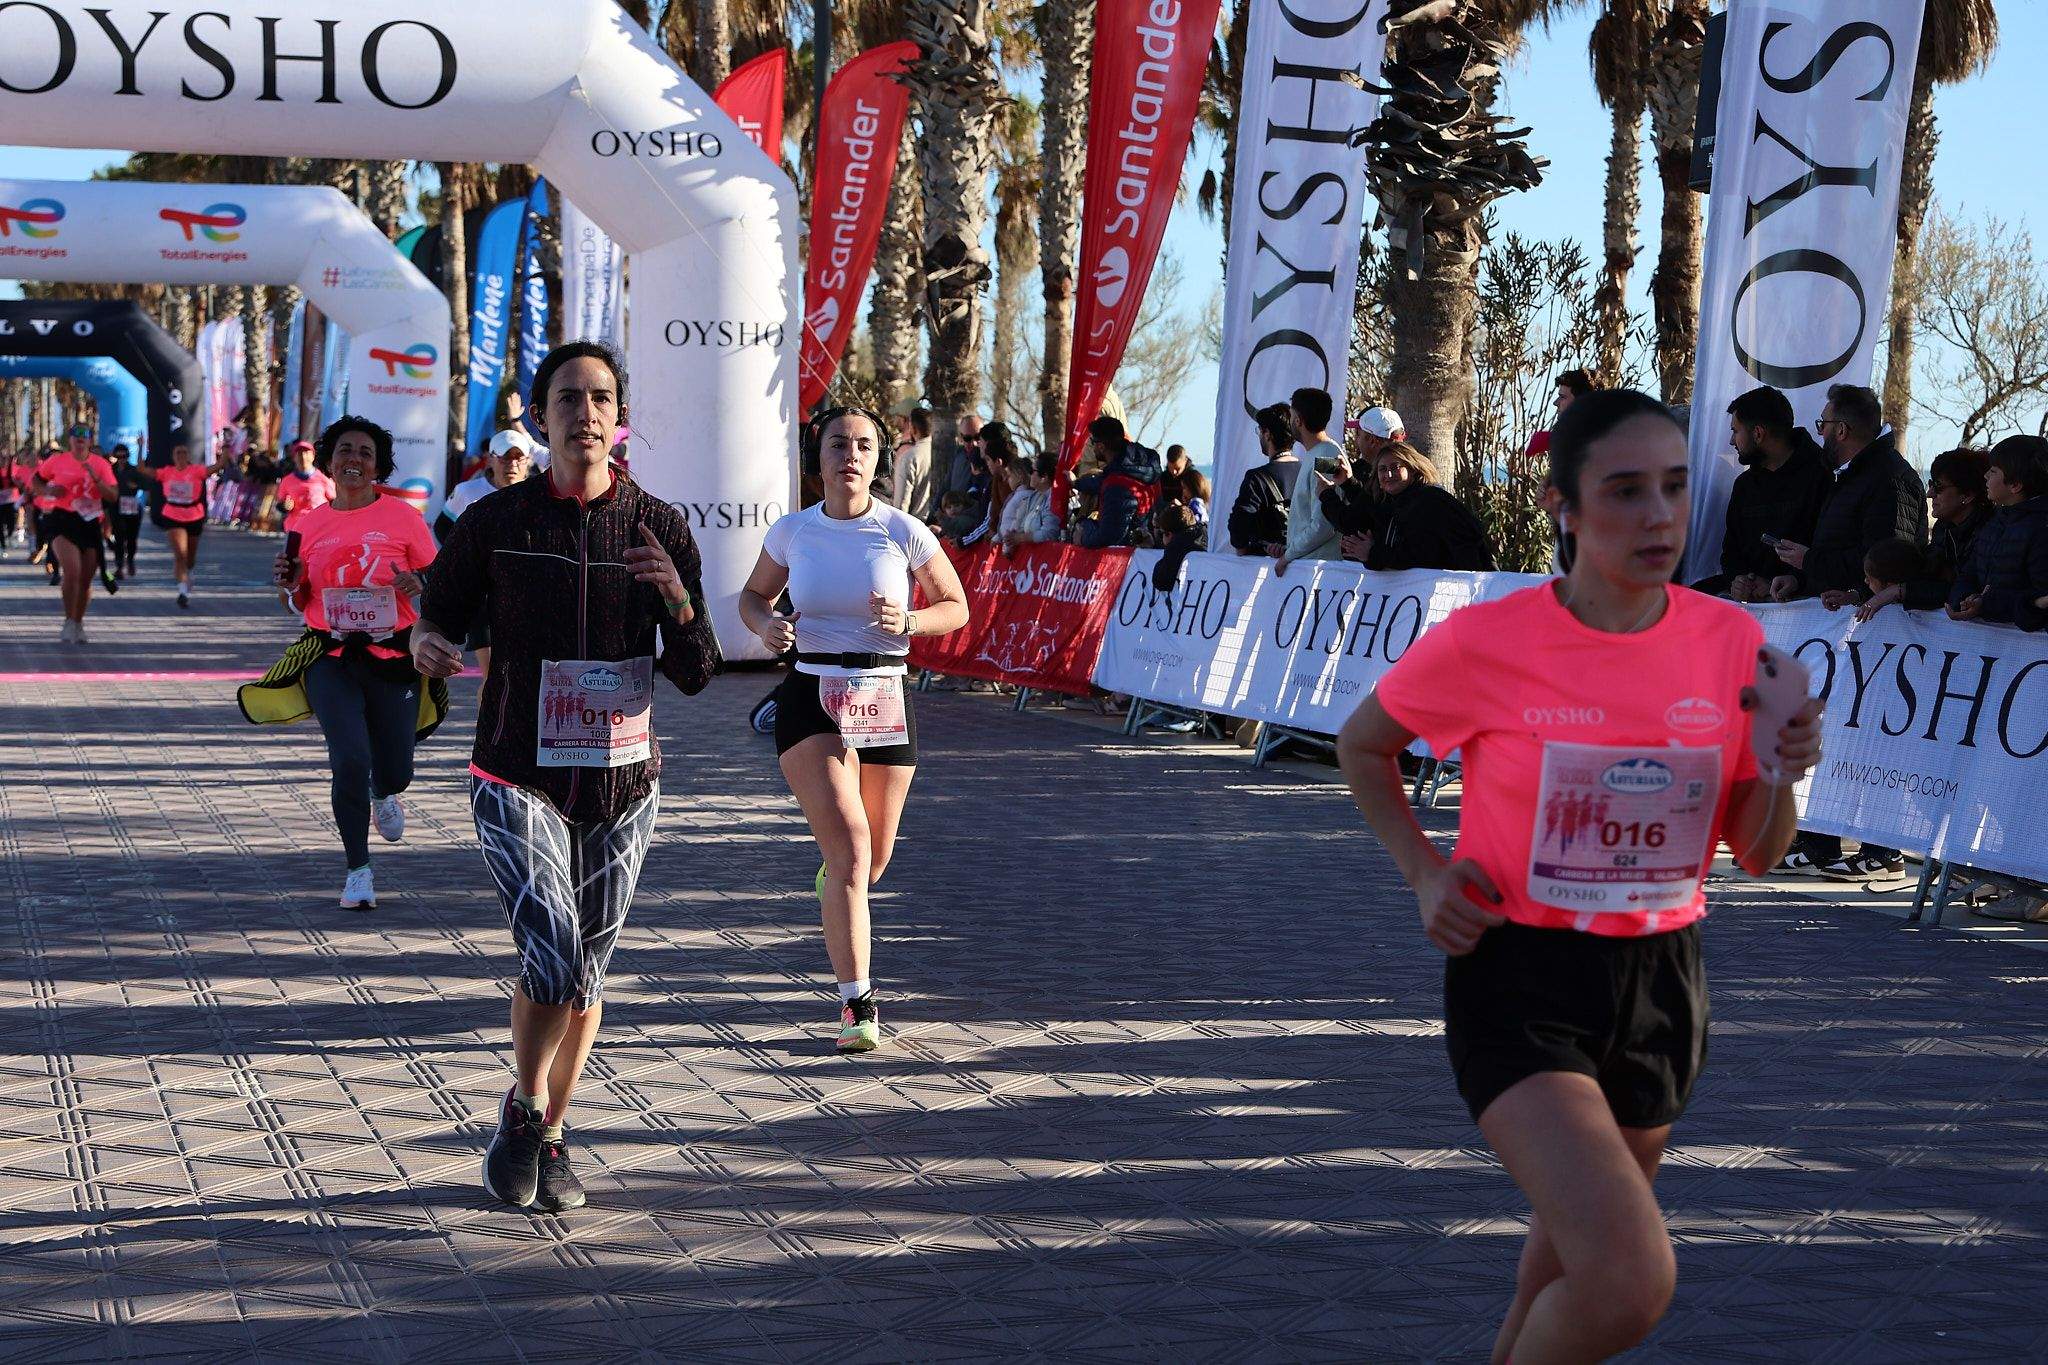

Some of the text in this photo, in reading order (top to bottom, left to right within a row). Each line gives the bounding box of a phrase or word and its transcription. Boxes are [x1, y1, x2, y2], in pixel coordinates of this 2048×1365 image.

[0, 1, 457, 109] OYSHO
[591, 130, 722, 158] OYSHO
[820, 97, 881, 291] Santander
[1731, 21, 1895, 390] OYS
[160, 249, 248, 263] TotalEnergies
[469, 274, 505, 388] Marlene
[665, 319, 784, 347] OYSHO
[1032, 563, 1107, 605] Santander
[349, 611, 376, 621] 016
[1275, 585, 1421, 663] OYSHO
[581, 709, 624, 726] 016
[849, 704, 878, 716] 016
[1524, 707, 1605, 725] OYSHO
[551, 751, 589, 760] OYSHO
[1831, 760, 1958, 801] WWW.OYSHO.COM
[1601, 821, 1666, 848] 016
[1554, 868, 1594, 880] CARRERA
[1549, 885, 1606, 901] OYSHO
